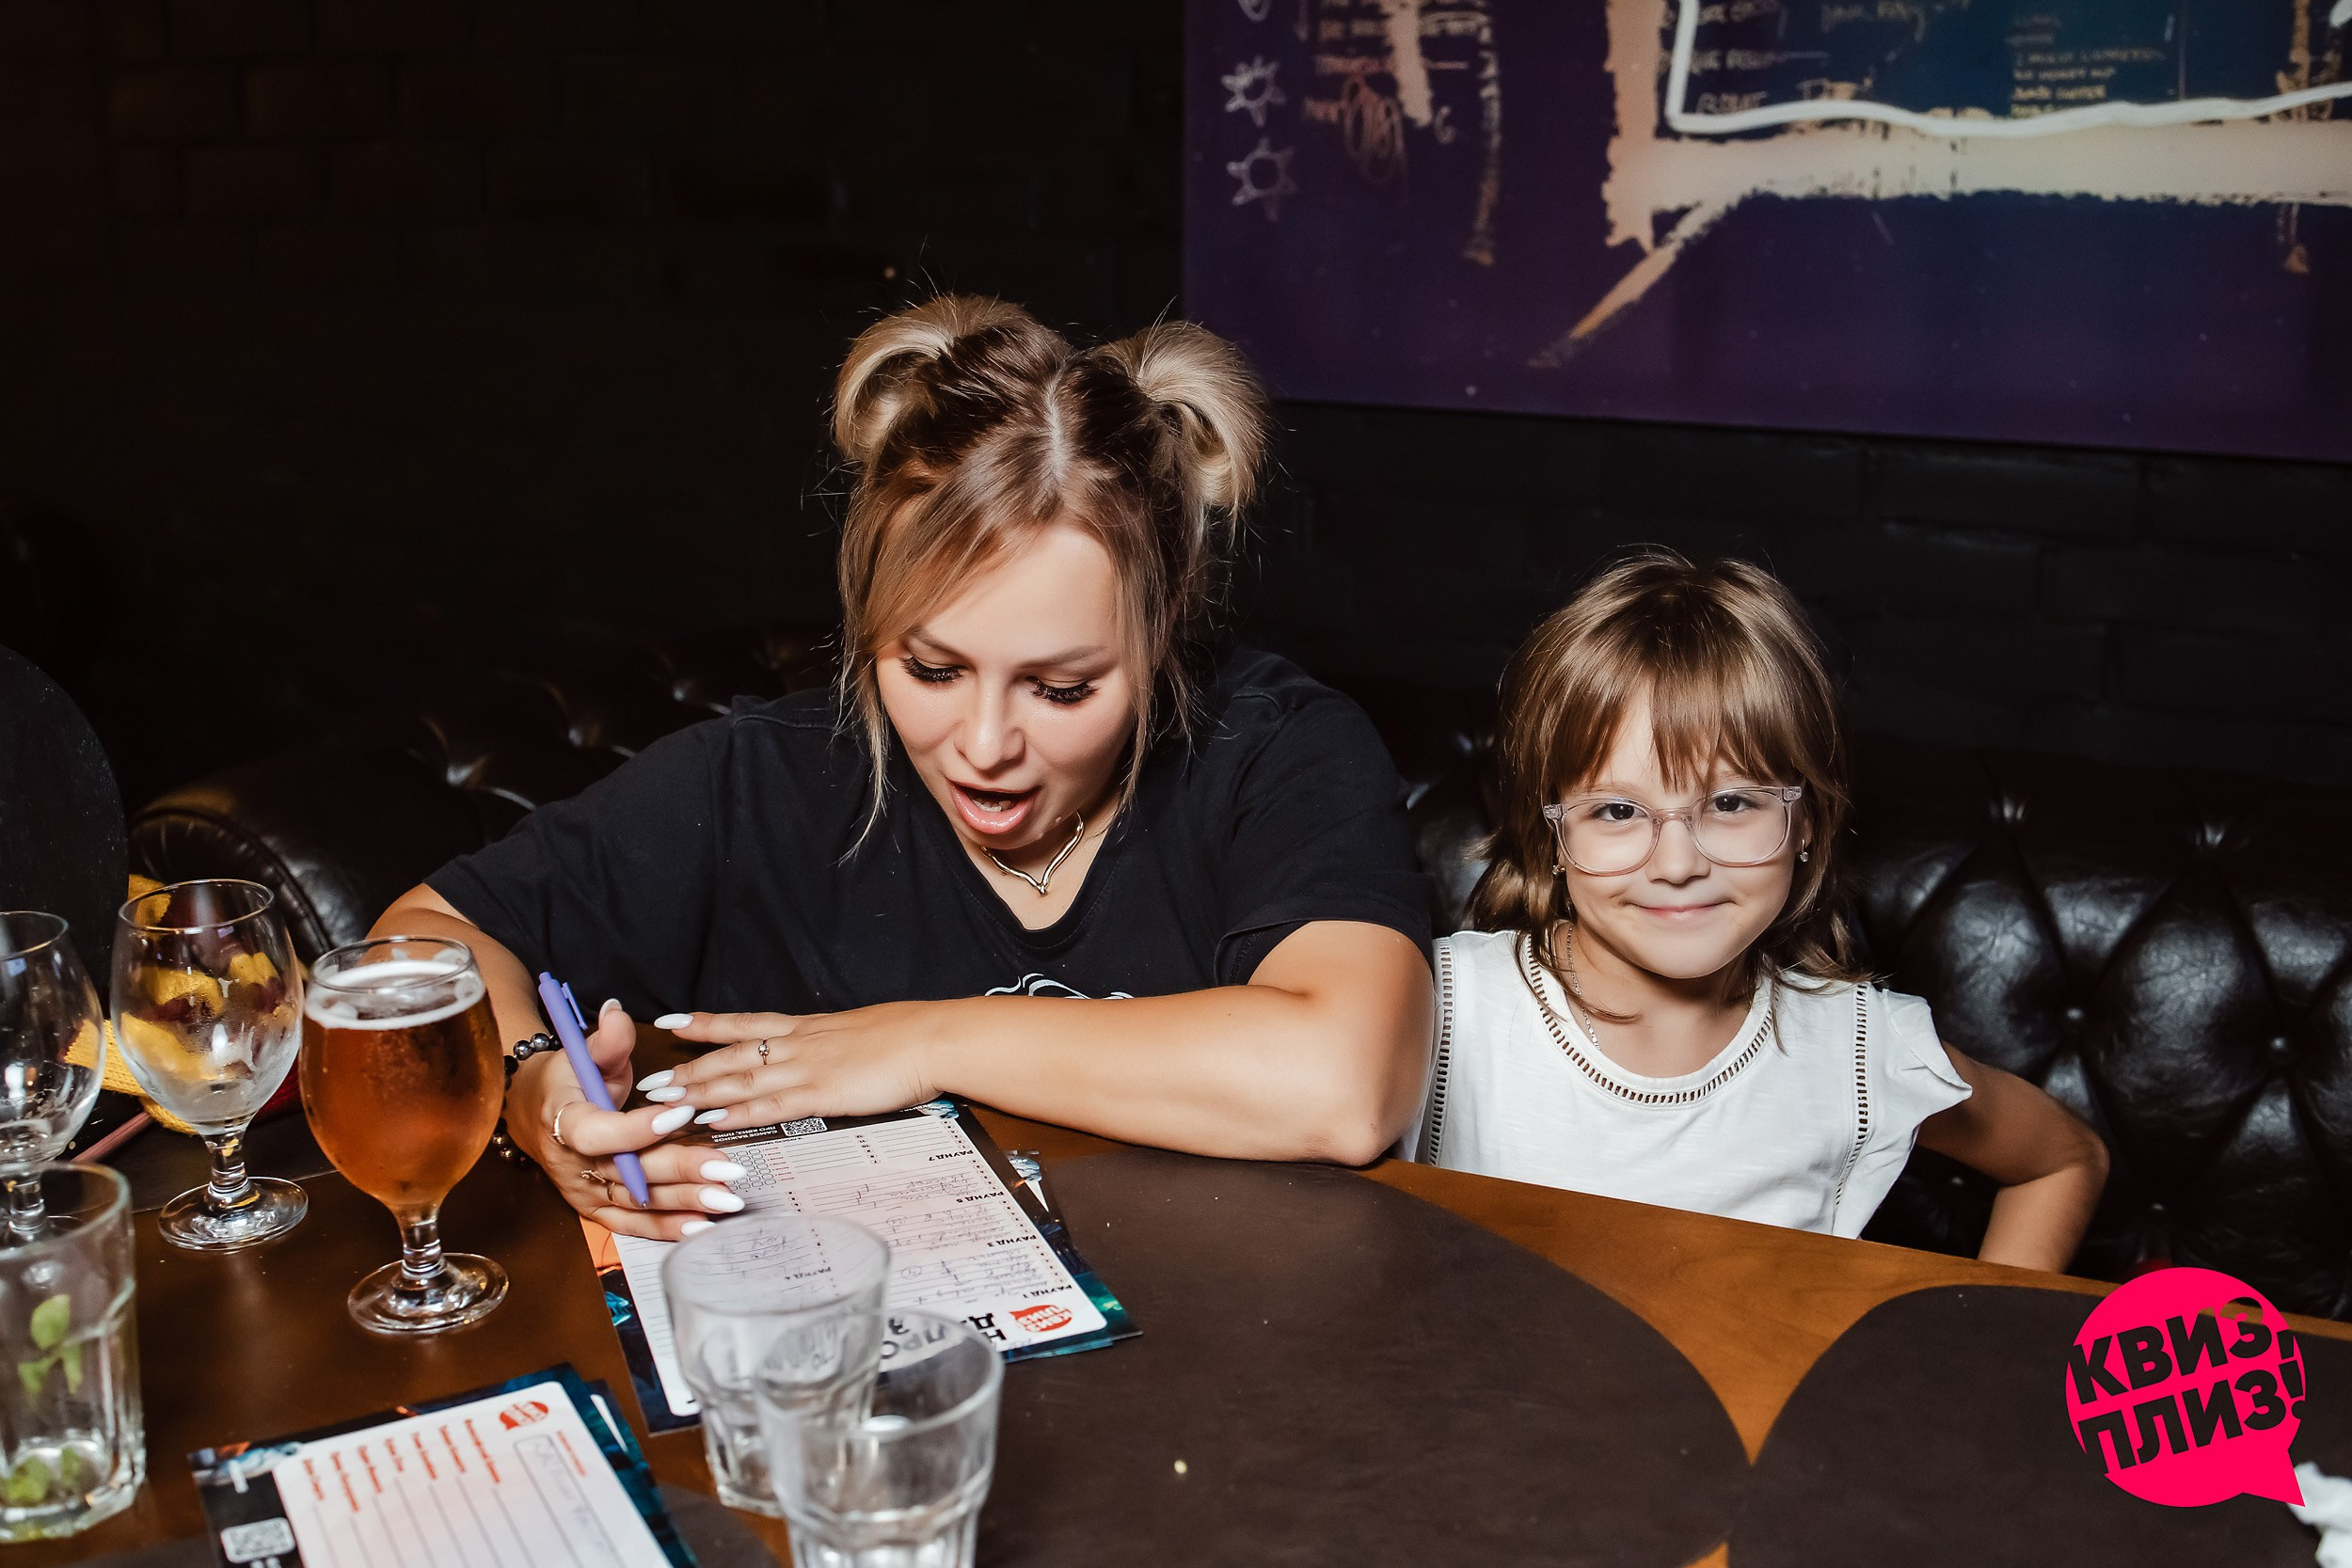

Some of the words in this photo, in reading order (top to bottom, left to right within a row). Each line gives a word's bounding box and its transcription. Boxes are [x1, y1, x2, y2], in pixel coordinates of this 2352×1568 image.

[936, 1149, 974, 1160] РАУНД
[964, 1191, 1005, 1202] РАУНД
[995, 1234, 1038, 1246] РАУНД
[1030, 1285, 1073, 1297] РАУНД
